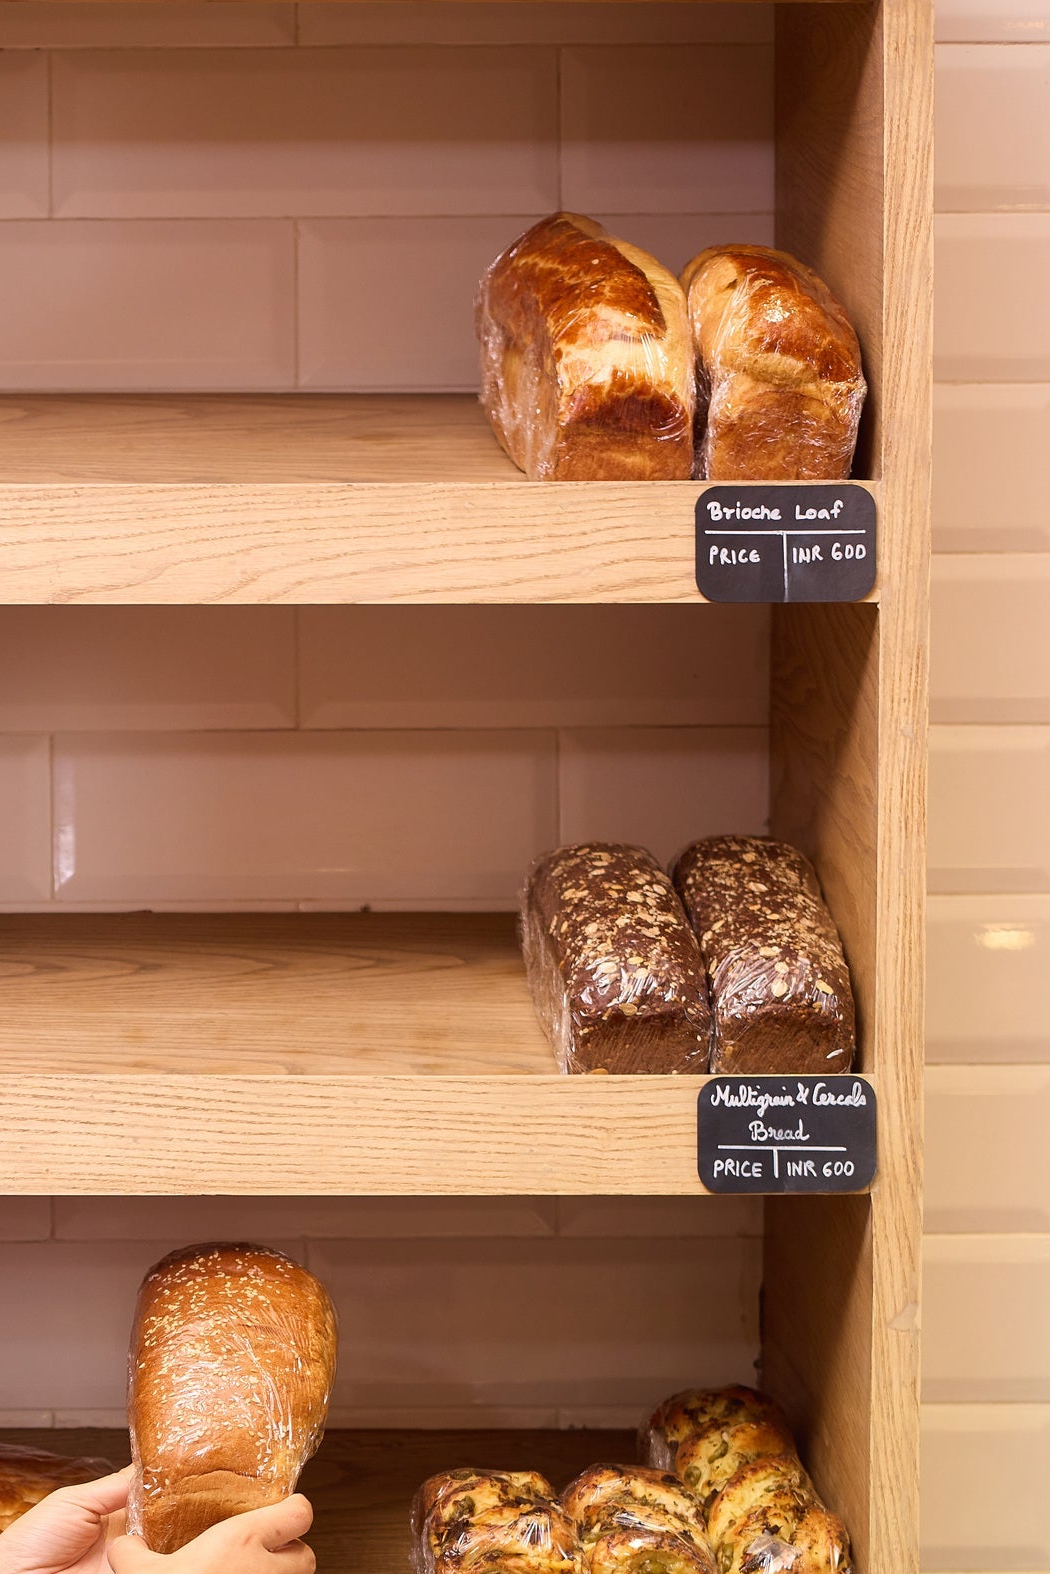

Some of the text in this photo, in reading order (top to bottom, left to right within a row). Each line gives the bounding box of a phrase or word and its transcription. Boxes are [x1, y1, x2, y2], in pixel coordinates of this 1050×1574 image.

[706, 499, 843, 521] Brioche Loaf
[708, 545, 761, 565] PRICE
[792, 545, 824, 564] INR
[710, 1084, 796, 1117] Multigrain
[812, 1081, 867, 1107] Cereals
[748, 1119, 810, 1142] Bread
[713, 1158, 855, 1178] PRICE INR 600
